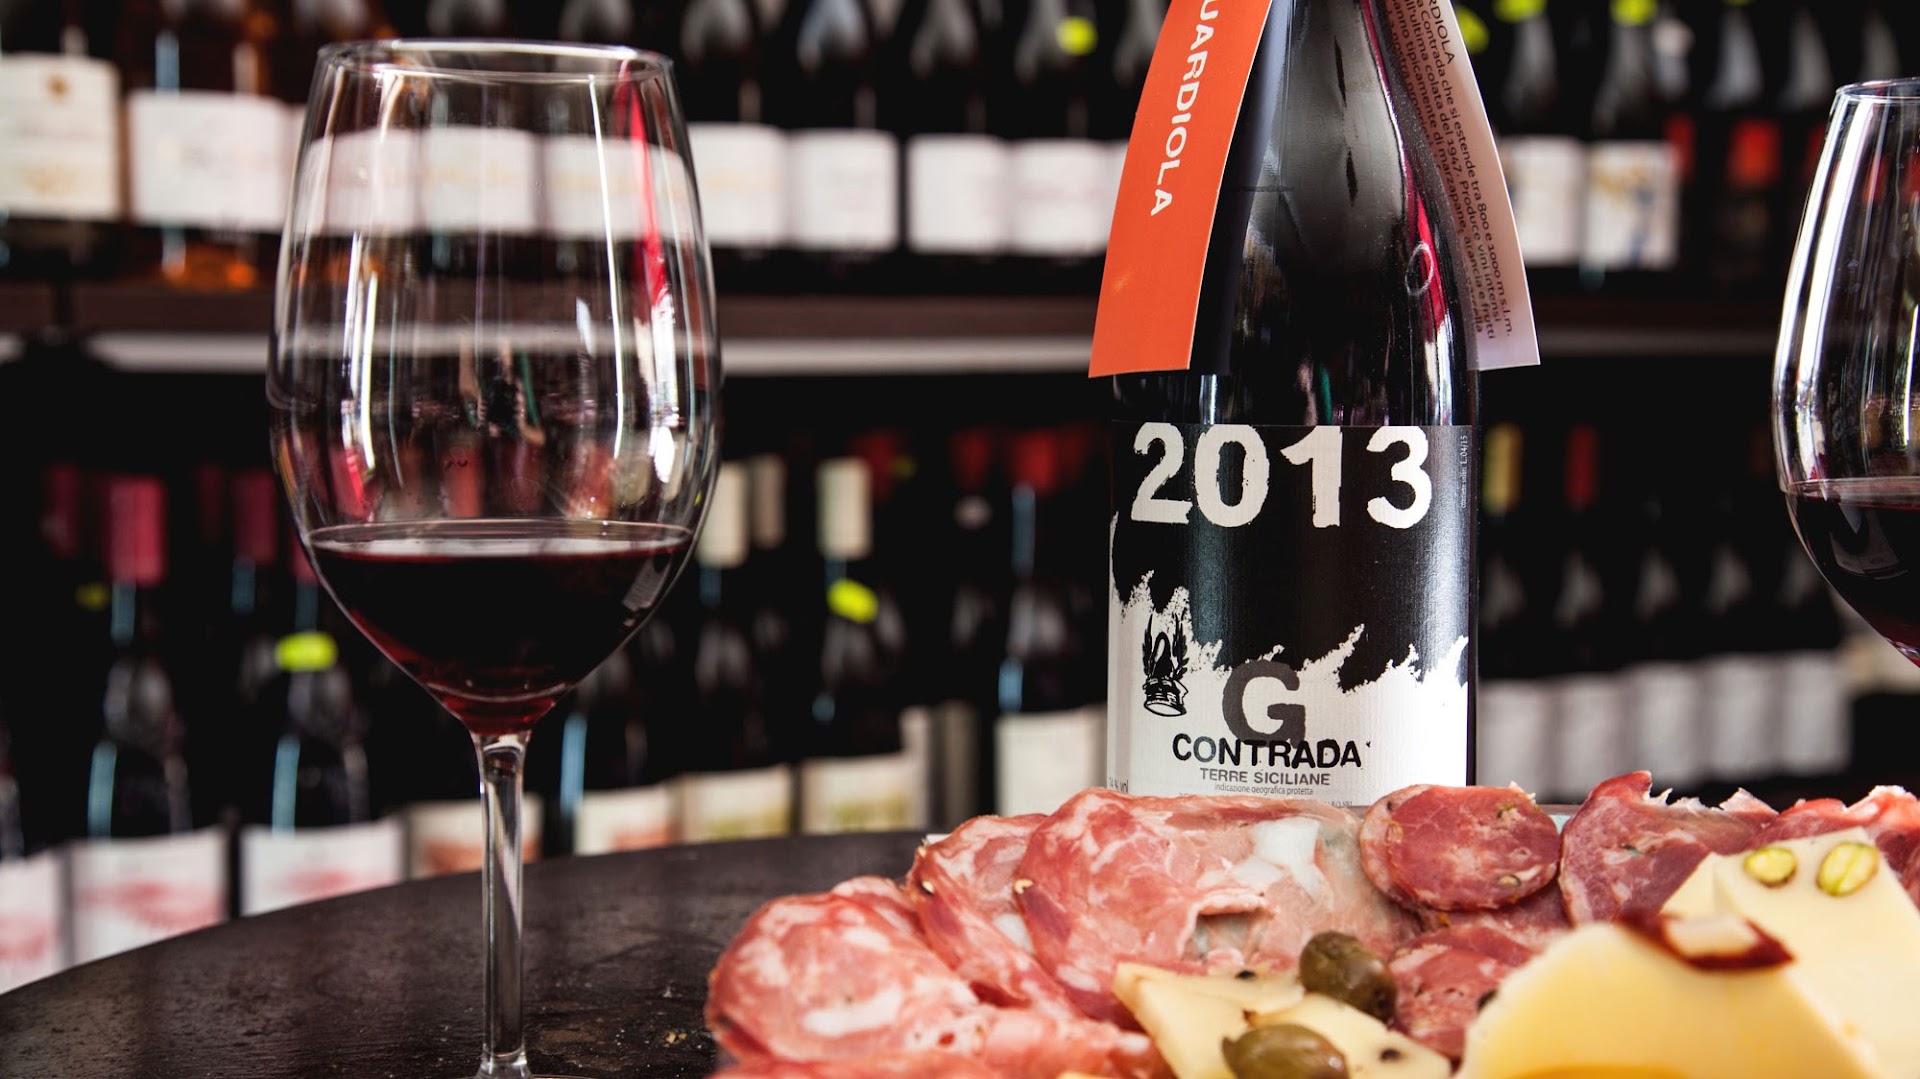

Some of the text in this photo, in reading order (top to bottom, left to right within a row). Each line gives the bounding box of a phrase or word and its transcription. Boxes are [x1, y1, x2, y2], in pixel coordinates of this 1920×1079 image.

[1421, 11, 1446, 77] Contrada
[1406, 42, 1437, 130] tipicamente
[1441, 79, 1454, 105] che
[1449, 107, 1461, 120] si
[1433, 131, 1445, 145] di
[1454, 122, 1475, 178] estende
[1424, 64, 1444, 109] colata
[1439, 112, 1453, 135] del
[1460, 180, 1481, 241] Produce
[1476, 243, 1488, 270] vini
[1482, 272, 1502, 322] intensi
[1471, 179, 1482, 200] tra
[1478, 204, 1489, 231] 800
[1485, 233, 1492, 241] e
[1464, 235, 1483, 288] arancia
[1485, 244, 1500, 277] 1000
[1478, 291, 1486, 300] e
[1494, 280, 1505, 296] m
[1481, 303, 1495, 339] frutti
[1131, 422, 1434, 528] 2013
[1222, 659, 1307, 748] G
[1172, 733, 1362, 768] CONTRADA
[1200, 767, 1331, 786] TERRE SICILIANE
[1214, 783, 1314, 797] indicazione geografica protetta
